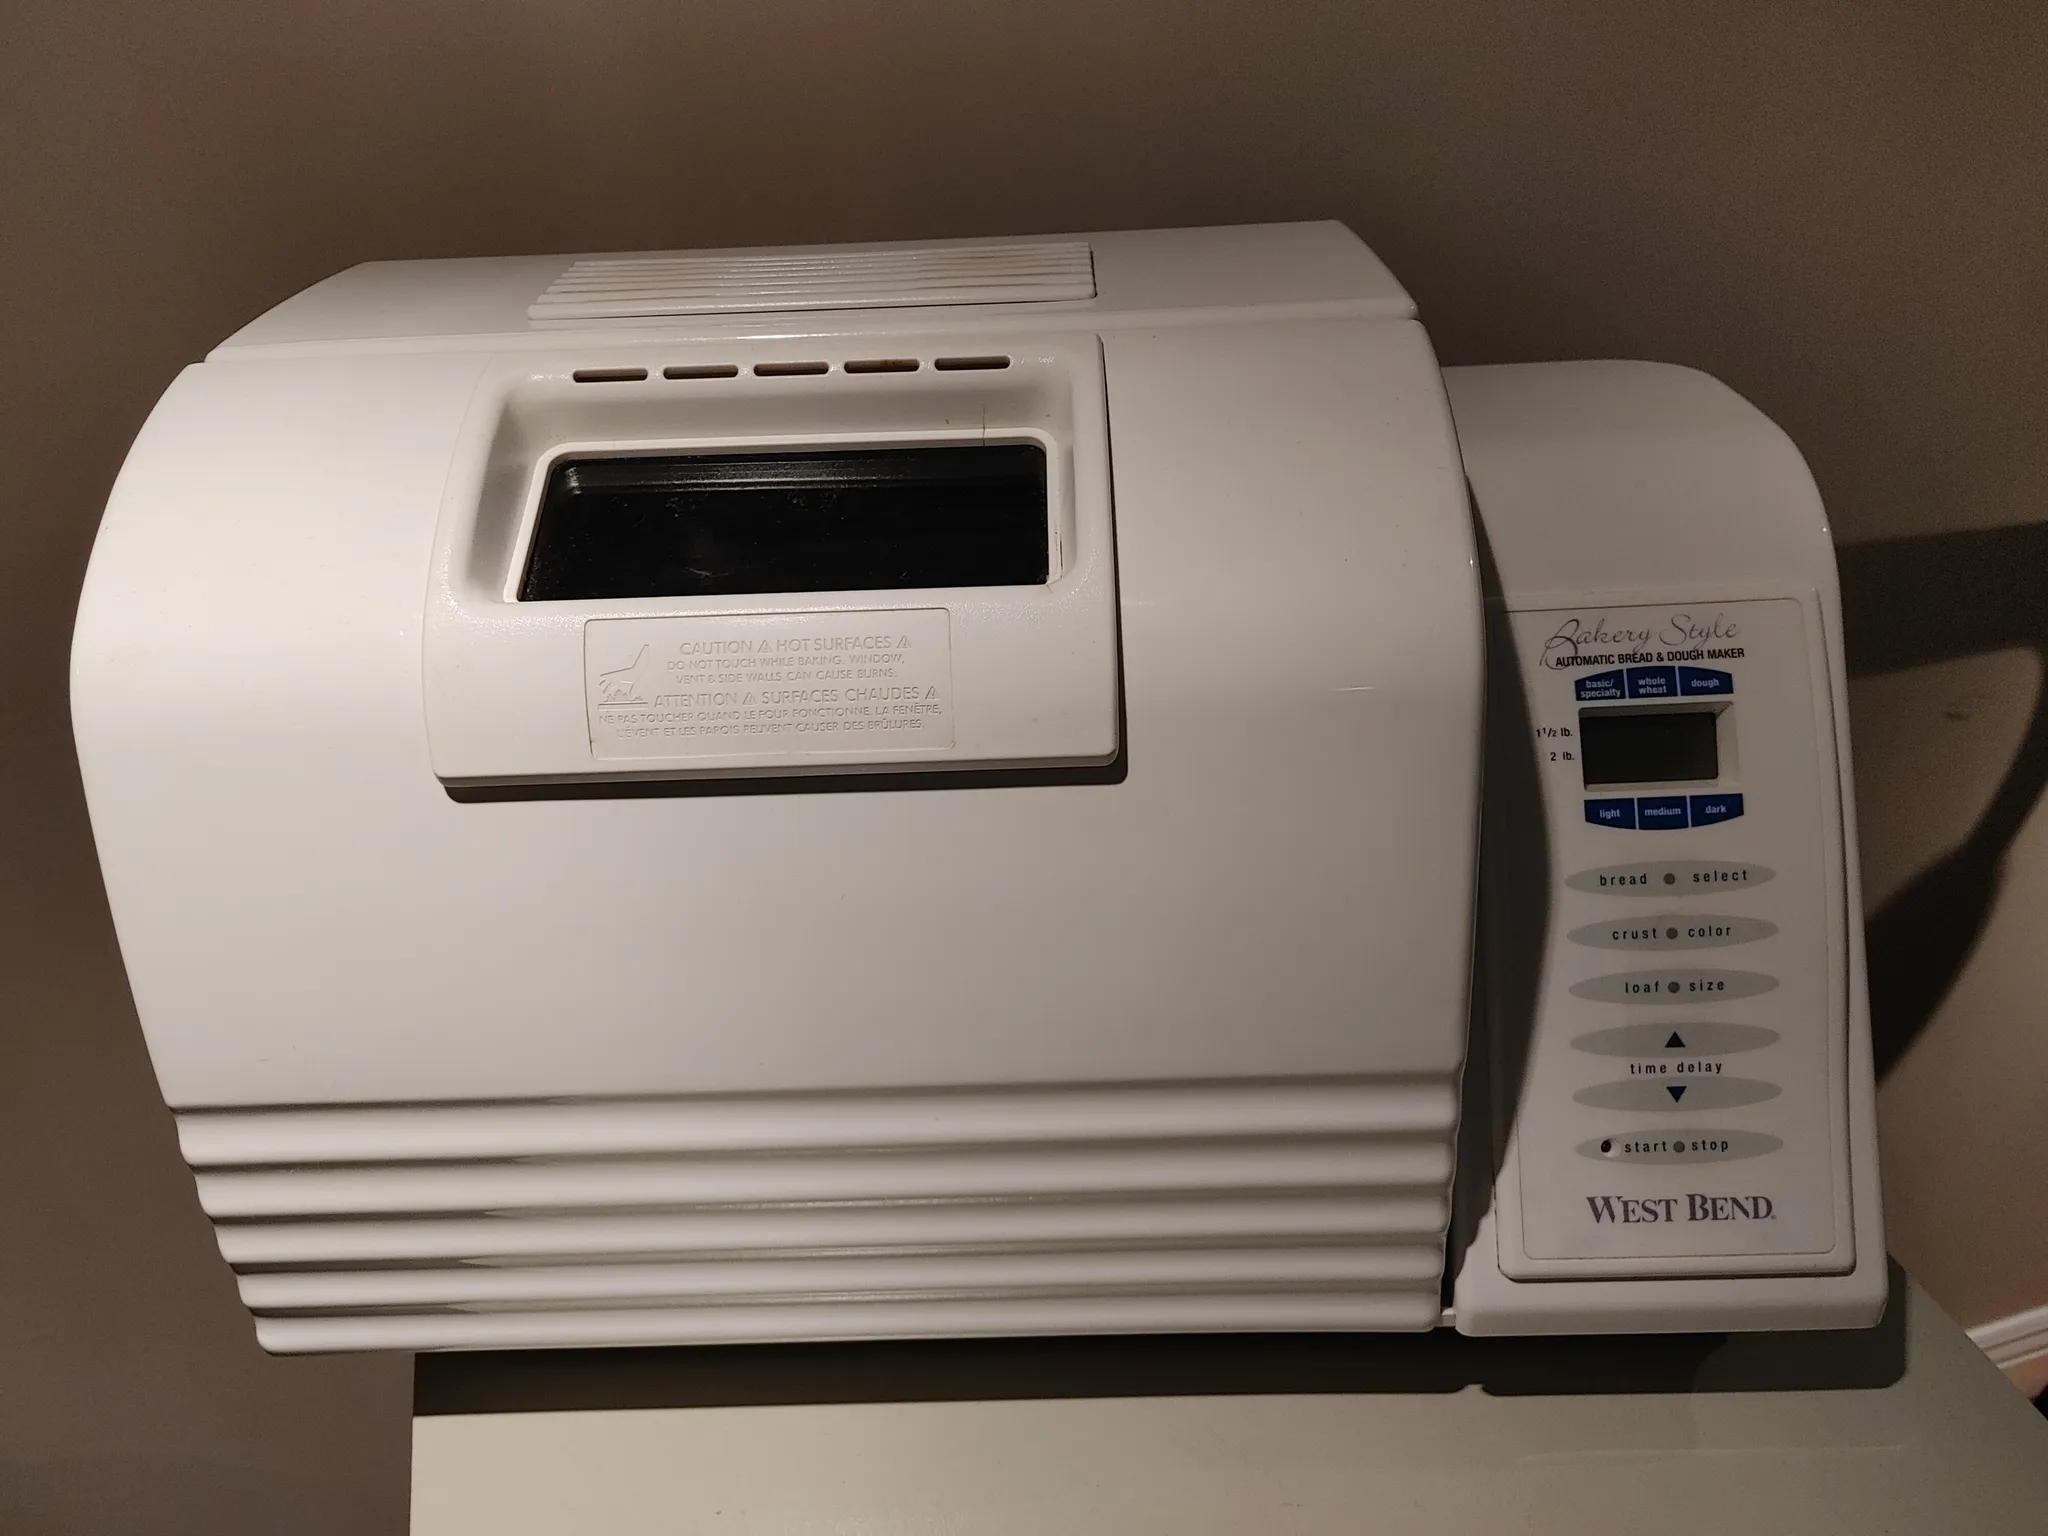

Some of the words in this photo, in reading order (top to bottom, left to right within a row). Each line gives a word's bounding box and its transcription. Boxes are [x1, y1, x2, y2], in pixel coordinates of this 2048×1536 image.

[680, 641, 752, 655] CAUTION
[777, 639, 810, 652] HOT
[814, 636, 892, 651] SURFACES
[1539, 618, 1651, 670] Bakery
[1659, 613, 1740, 650] Style
[668, 661, 685, 671] DO
[689, 660, 716, 670] NOT
[716, 659, 756, 668] TOUCH
[759, 657, 794, 667] WHILE
[849, 653, 905, 665] WINDOW,
[1556, 654, 1615, 667] AUTOMATIC
[1618, 652, 1653, 664] BREAD
[1657, 652, 1664, 662] &
[1667, 650, 1704, 661] DOUGH
[1707, 648, 1745, 659] MAKER
[676, 675, 705, 684] VENT
[708, 674, 715, 683] &
[719, 673, 743, 683] SIDE
[746, 672, 782, 682] WALLS
[787, 671, 811, 681] CAN
[816, 670, 853, 680] CAUSE
[1586, 679, 1613, 688] basic/
[1638, 677, 1665, 685] whole
[1691, 678, 1719, 688] dough
[1580, 689, 1621, 699] specialty
[1638, 686, 1666, 694] wheat
[654, 693, 737, 707] ATTENTION
[761, 689, 838, 704] SURFACES
[845, 687, 920, 701] CHAUDES
[599, 716, 614, 724] NE
[618, 715, 637, 724] PAS
[640, 713, 693, 723] TOUCHER
[698, 711, 740, 721] QUAND
[744, 710, 756, 720] LE
[759, 709, 788, 719] FOUR
[875, 706, 888, 716] LA
[893, 703, 942, 715] FENÊTRE,
[664, 727, 676, 737] ET
[679, 727, 696, 736] LES
[700, 725, 739, 735] PAROIS
[744, 724, 792, 734] PEUVENT
[796, 722, 838, 732] CAUSER
[844, 721, 863, 730] DES
[1561, 728, 1573, 737] lb.
[1550, 753, 1556, 761] 2
[1563, 752, 1575, 760] lb.
[1600, 810, 1620, 818] light
[1645, 807, 1681, 816] medium
[1705, 805, 1726, 814] dark
[1600, 873, 1647, 886] bread
[1693, 870, 1748, 882] select
[1612, 928, 1657, 940] crust
[1688, 926, 1731, 938] color
[1625, 981, 1659, 994] loaf
[1689, 980, 1724, 991] size
[1630, 1063, 1667, 1074] time
[1677, 1061, 1722, 1073] delay
[1625, 1141, 1667, 1152] start
[1691, 1140, 1728, 1152] stop
[1586, 1195, 1678, 1224] WEST
